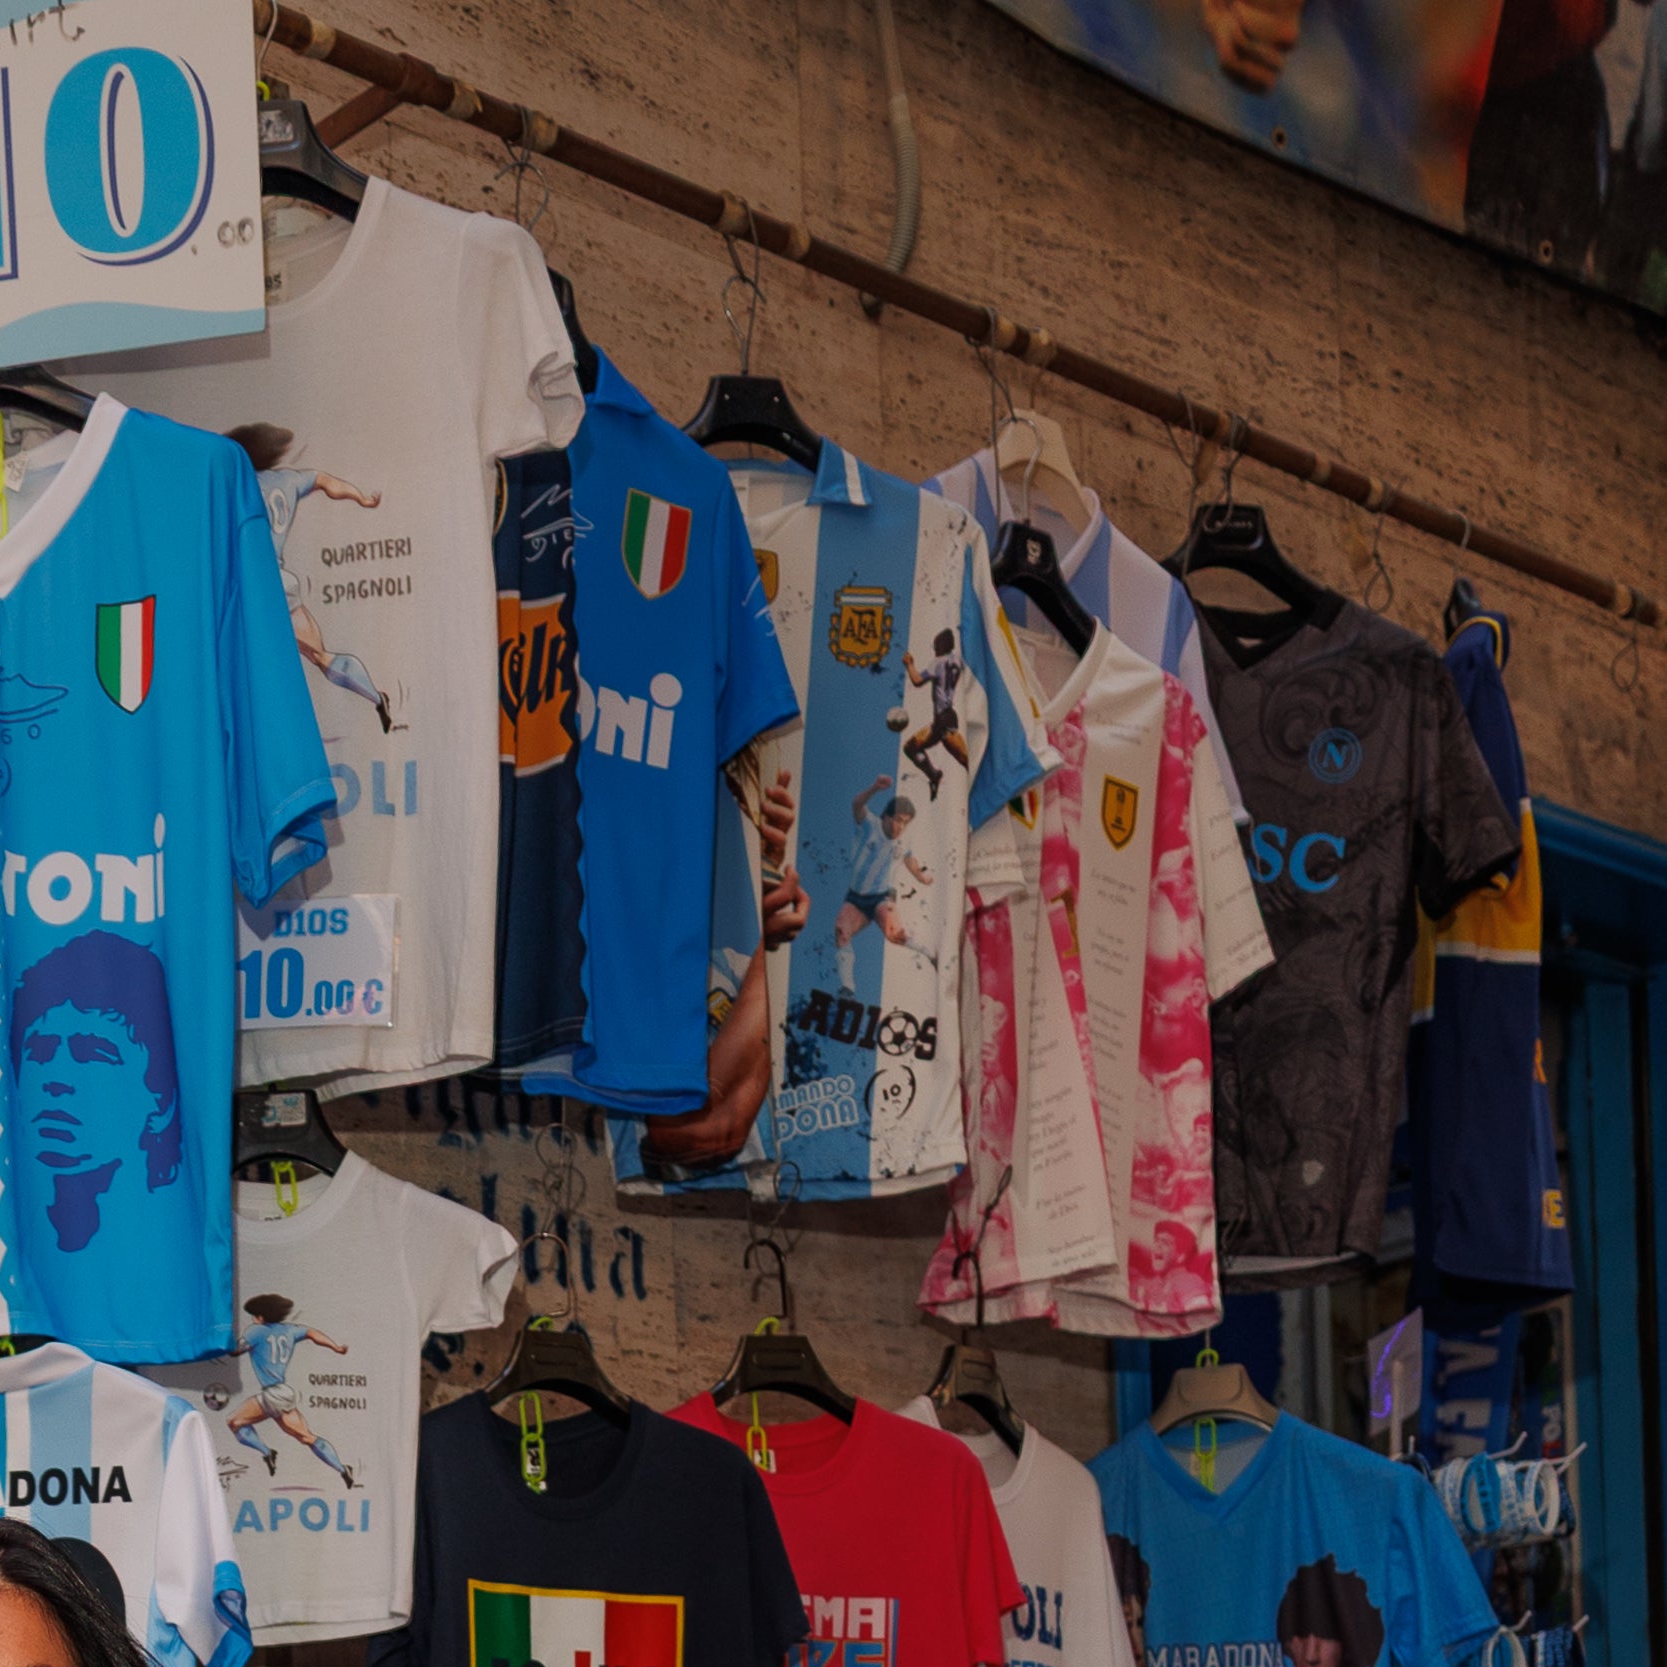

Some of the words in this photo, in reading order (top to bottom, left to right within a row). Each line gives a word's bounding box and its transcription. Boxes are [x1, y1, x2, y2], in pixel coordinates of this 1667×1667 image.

[321, 537, 412, 567] QUARTIERI
[321, 577, 412, 605] SPAGNOLI
[1247, 822, 1346, 893] SC
[309, 1373, 367, 1387] QUARTIERI
[309, 1397, 367, 1410] SPAGNOLI
[233, 1497, 370, 1534] APOLI
